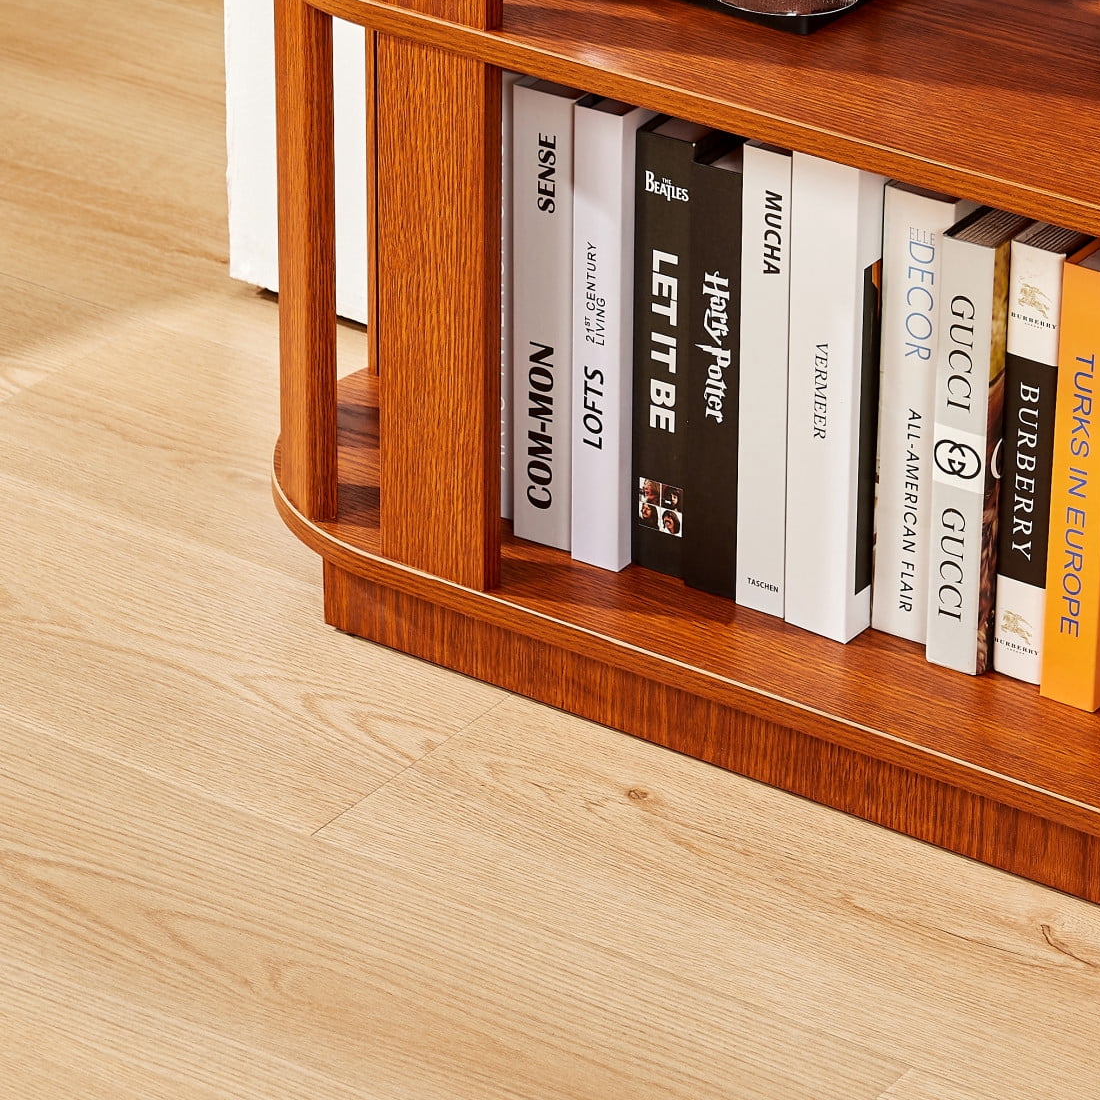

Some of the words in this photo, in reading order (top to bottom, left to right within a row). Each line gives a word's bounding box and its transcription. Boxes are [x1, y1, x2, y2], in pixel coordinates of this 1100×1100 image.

[537, 132, 557, 214] SENSE
[645, 170, 689, 202] BEATLES
[662, 177, 672, 185] THE
[763, 189, 783, 276] MUCHA
[909, 226, 936, 246] ELLE
[586, 241, 597, 311] CENTURY
[651, 250, 679, 327] LET
[702, 270, 730, 346] Harry
[904, 241, 935, 361] DECOR
[595, 297, 606, 346] LIVING
[650, 331, 677, 374] IT
[947, 294, 975, 414] GUCCI
[583, 365, 604, 450] LOFTS
[650, 378, 676, 434] BE
[694, 343, 731, 424] Potter
[813, 343, 829, 439] VERMEER
[1070, 354, 1095, 459] TURKS
[526, 341, 555, 510] COM-MON
[903, 408, 922, 553] ALL-AMERICAN
[1012, 381, 1040, 562] BURBERRY
[1068, 466, 1088, 499] IN
[747, 577, 779, 593] TASCHEN
[899, 560, 915, 613] FLAIR
[938, 507, 966, 622] GUCCI
[1060, 506, 1086, 638] EUROPE
